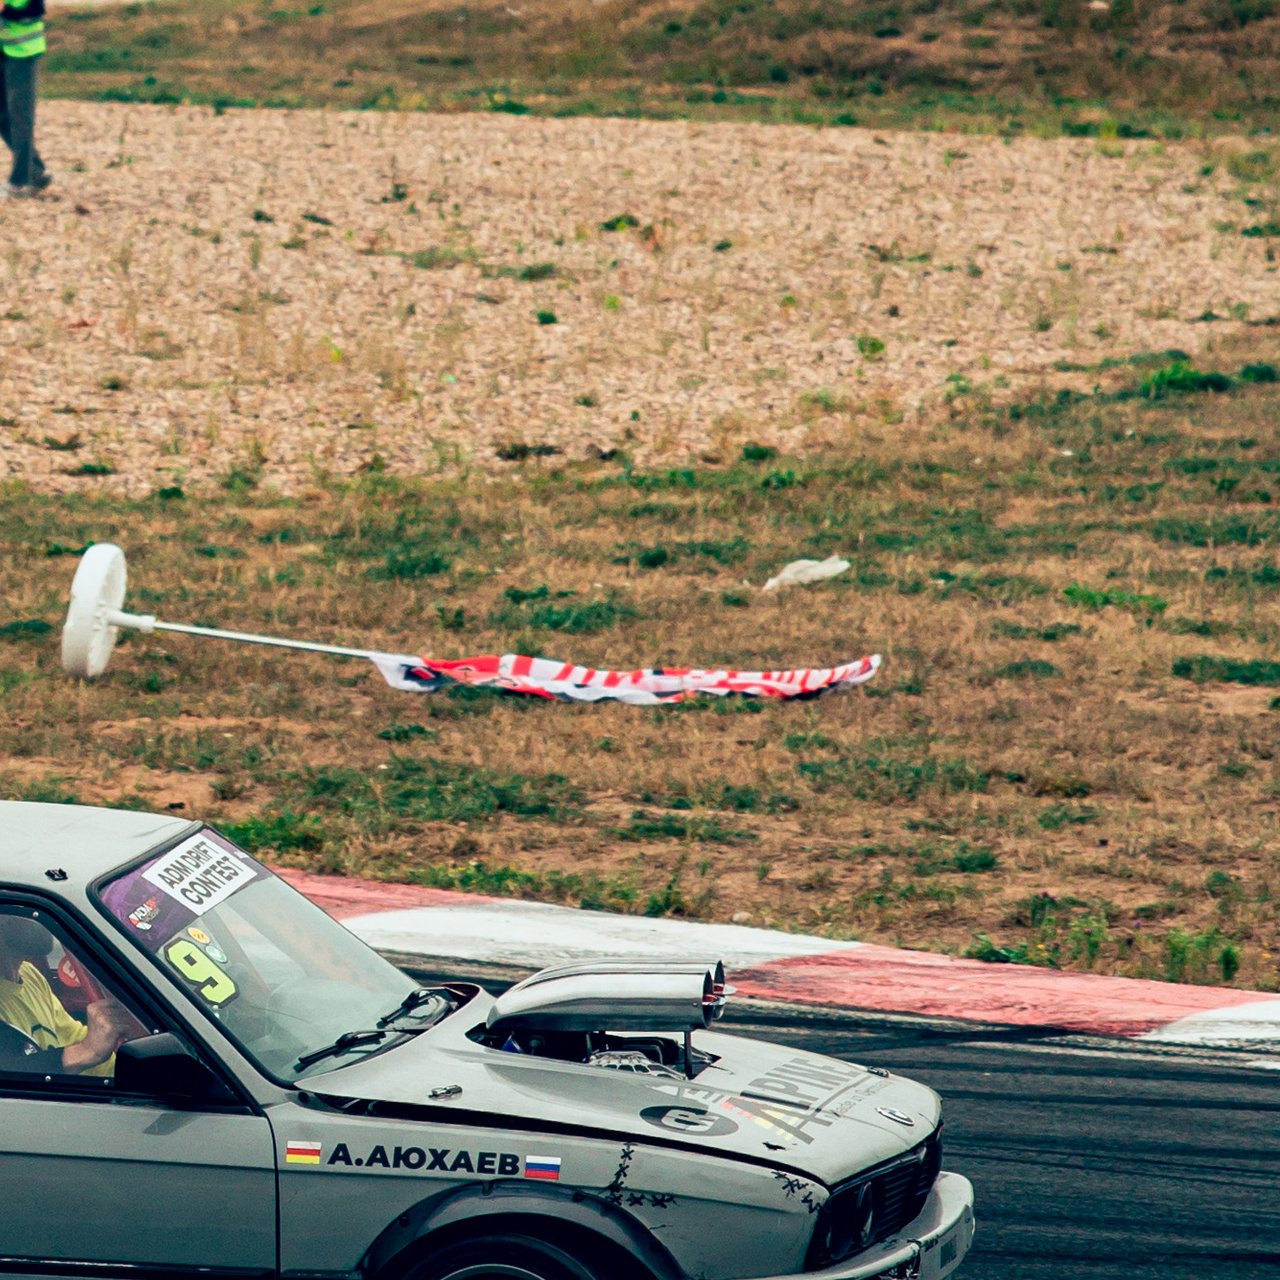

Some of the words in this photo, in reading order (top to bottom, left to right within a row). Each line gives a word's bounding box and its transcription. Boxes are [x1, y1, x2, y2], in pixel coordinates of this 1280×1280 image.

[157, 859, 190, 889] ADM
[180, 841, 219, 869] DRIFT
[180, 856, 244, 905] CONTEST
[166, 939, 237, 1005] 9
[723, 1057, 862, 1145] ALPINE
[327, 1143, 520, 1175] А.АЮХАЕВ
